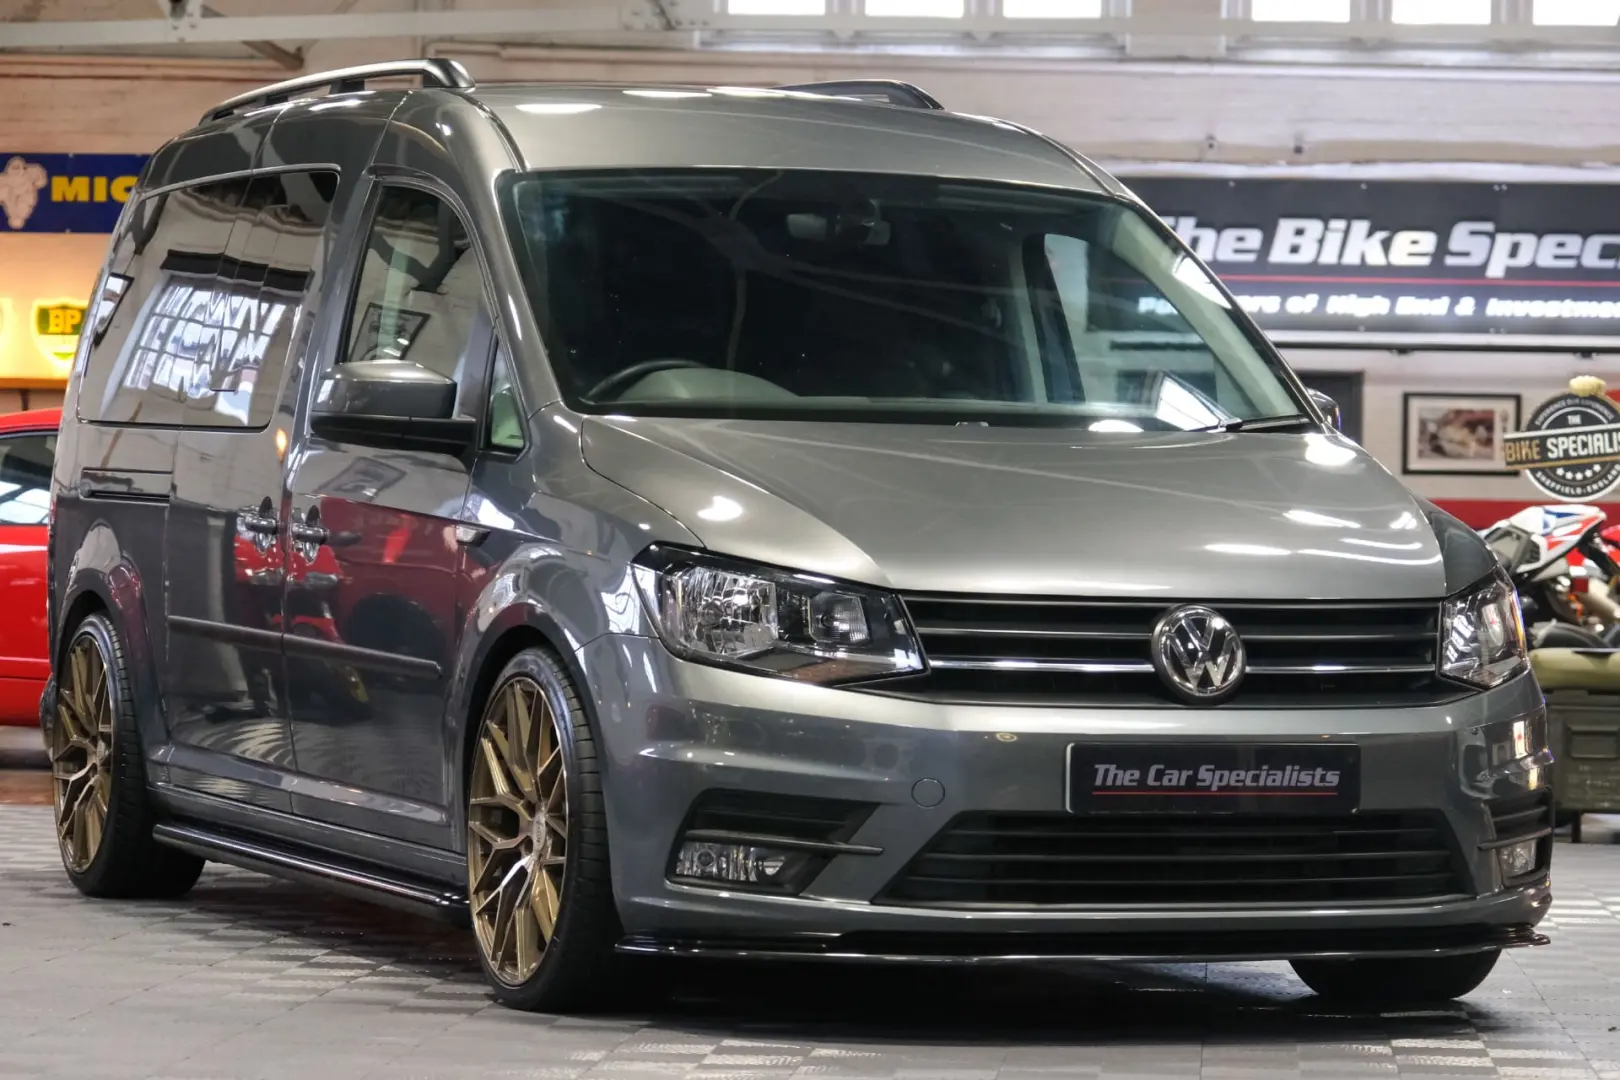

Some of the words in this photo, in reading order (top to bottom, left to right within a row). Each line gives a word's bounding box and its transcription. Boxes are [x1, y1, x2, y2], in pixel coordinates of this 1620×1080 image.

[51, 176, 138, 203] MIC
[1267, 218, 1438, 266] Bike
[1444, 220, 1620, 278] Spec
[1285, 293, 1319, 313] of
[48, 308, 82, 334] BP
[1567, 414, 1581, 425] THE
[1505, 440, 1541, 461] BIKE
[1535, 471, 1582, 495] SHEFFIELD
[1094, 764, 1140, 786] The
[1147, 764, 1193, 786] Car
[1196, 764, 1341, 791] Specialists
